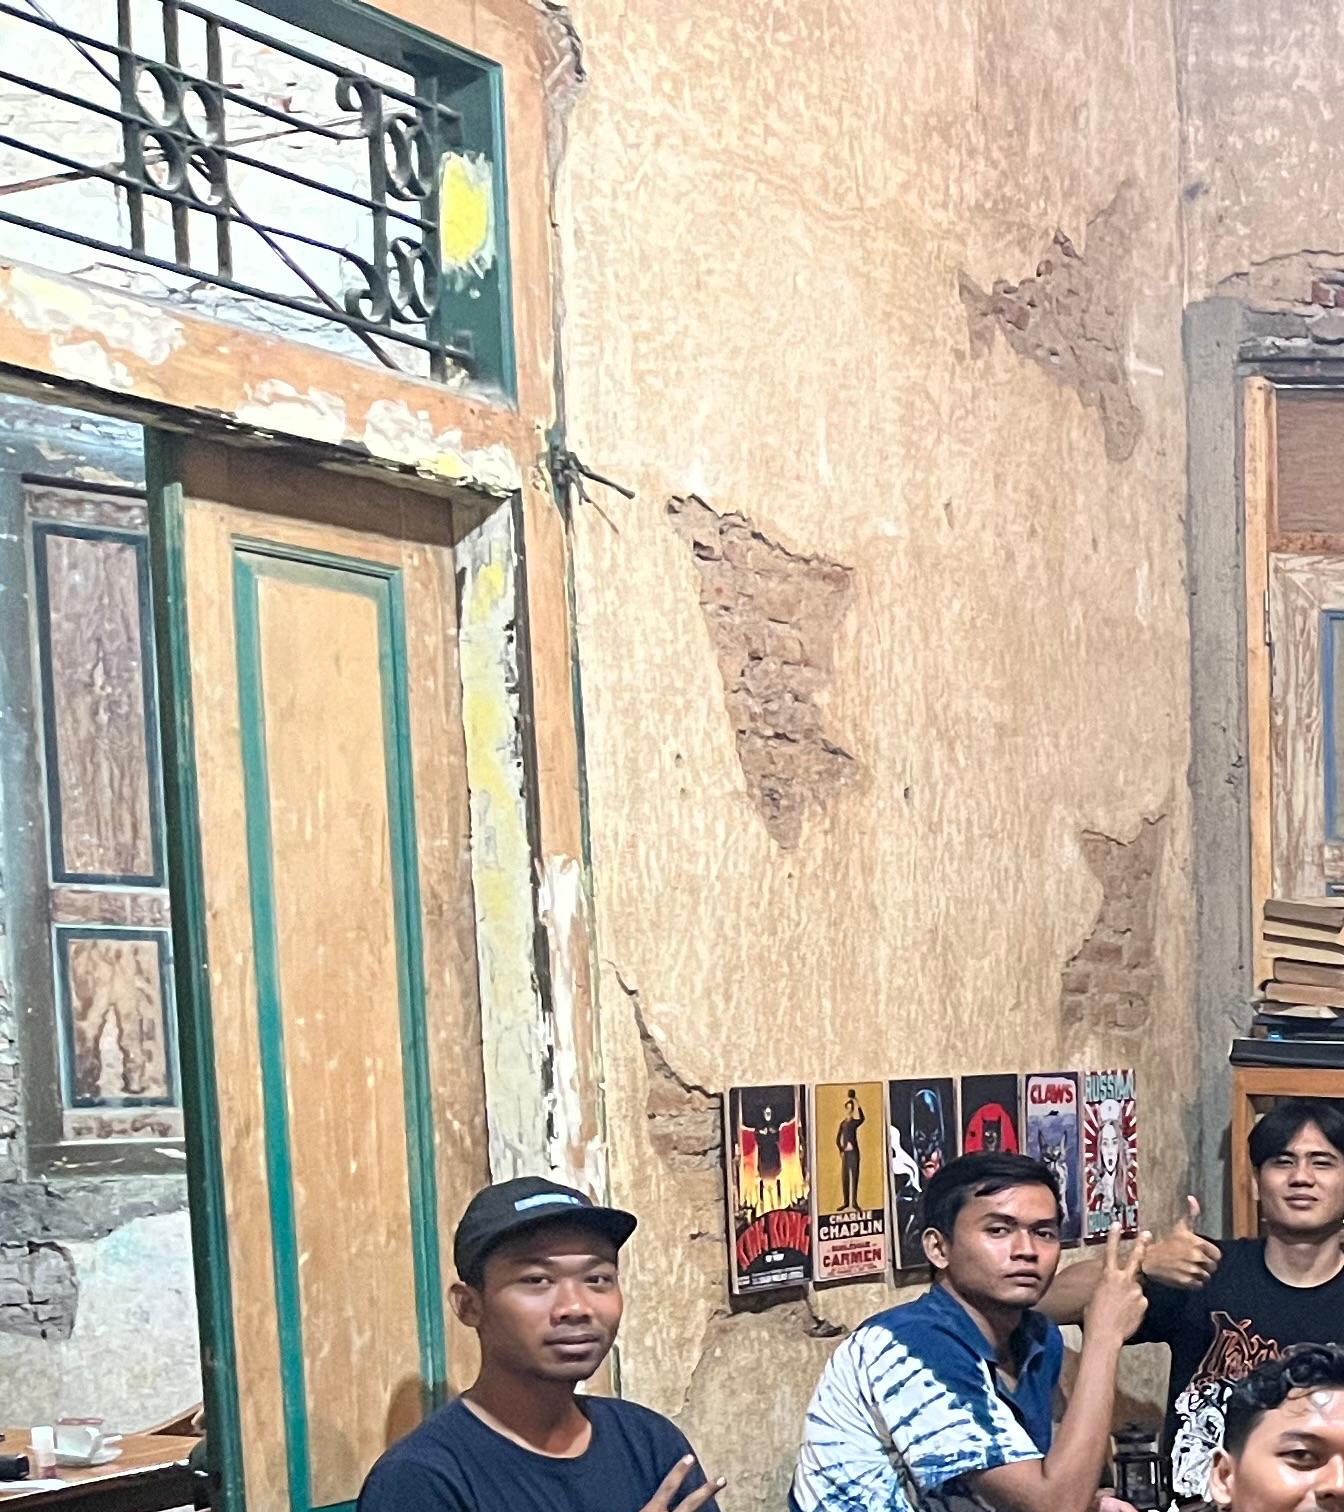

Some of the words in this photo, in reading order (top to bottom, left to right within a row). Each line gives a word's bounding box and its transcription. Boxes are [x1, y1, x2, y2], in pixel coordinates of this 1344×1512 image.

[1030, 1084, 1073, 1104] CLAWS
[829, 1211, 873, 1223] CHARLIE
[819, 1219, 883, 1240] CHAPLIN
[736, 1216, 769, 1271] KING
[769, 1211, 811, 1256] KONG
[823, 1248, 882, 1267] CARMEN
